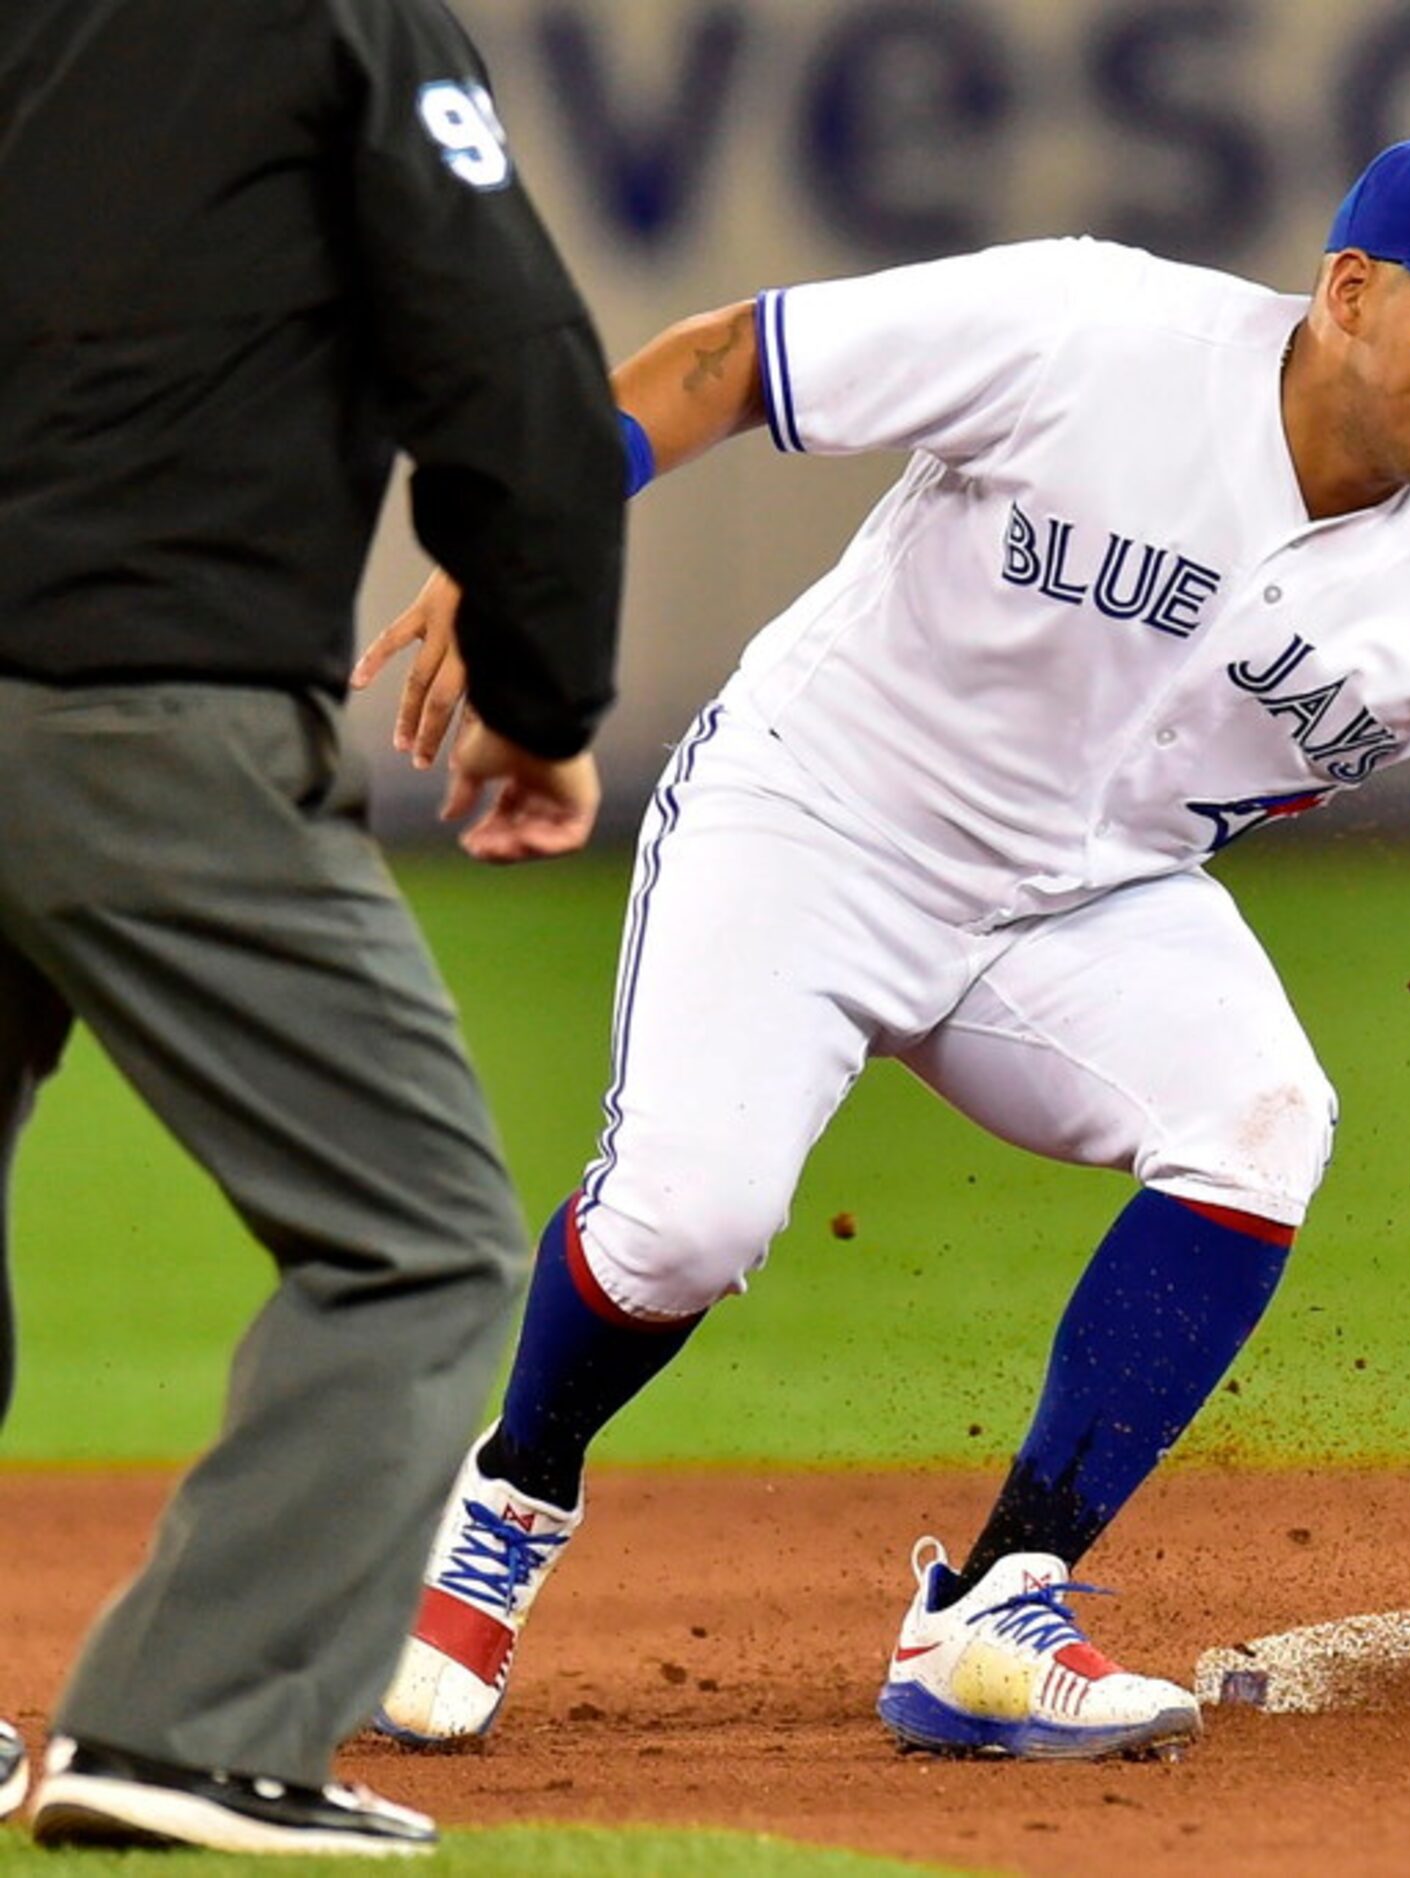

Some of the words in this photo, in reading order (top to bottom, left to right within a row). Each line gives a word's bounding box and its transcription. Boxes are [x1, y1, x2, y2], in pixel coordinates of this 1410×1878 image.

[418, 79, 510, 191] 9
[1002, 501, 1221, 638] BLUE
[1227, 634, 1400, 784] JAYS
